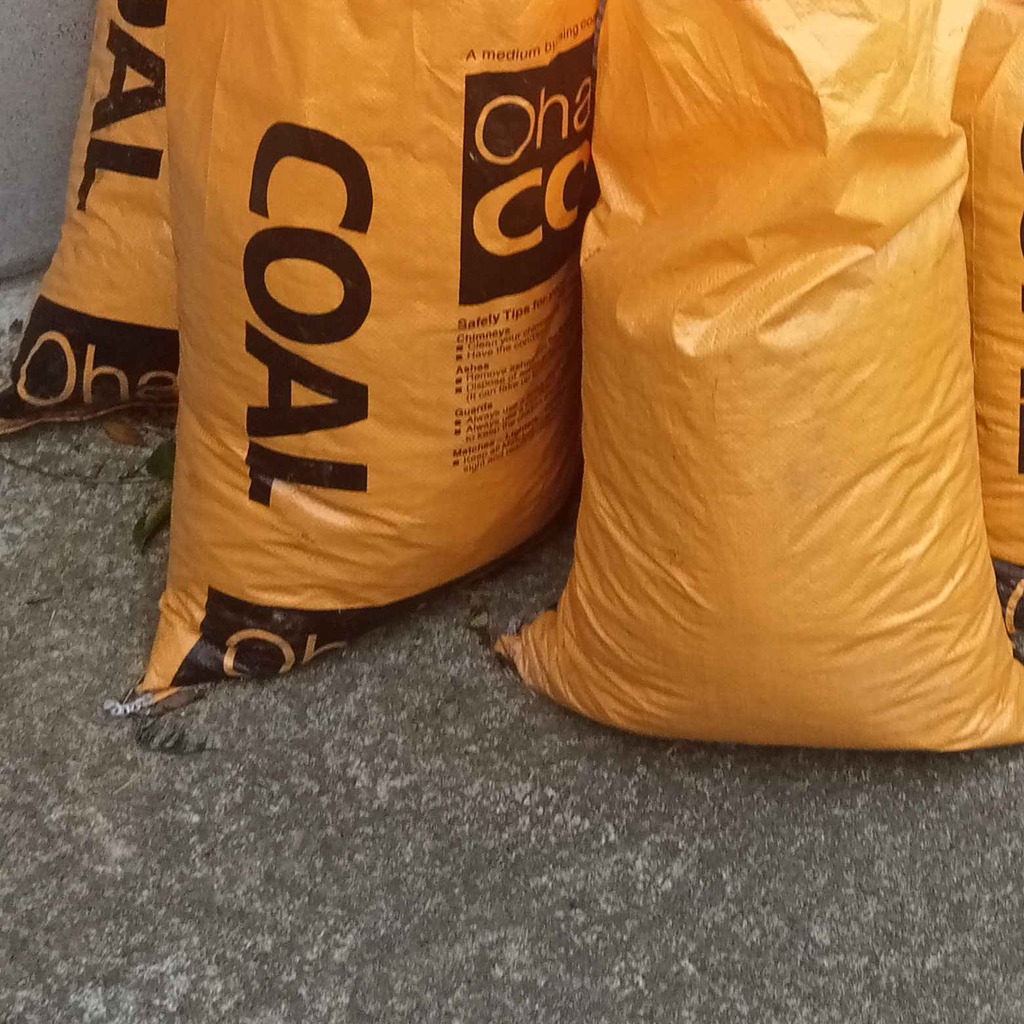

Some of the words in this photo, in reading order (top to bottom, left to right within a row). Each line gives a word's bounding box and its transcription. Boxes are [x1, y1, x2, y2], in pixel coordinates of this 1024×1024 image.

[466, 49, 477, 61] A
[482, 46, 541, 61] medium
[544, 26, 579, 53] bing
[242, 121, 374, 508] COAL
[458, 313, 500, 331] Safety
[502, 306, 530, 322] Tips
[457, 328, 511, 344] Chimneys
[456, 362, 490, 376] Ashes
[454, 401, 493, 419] Guards
